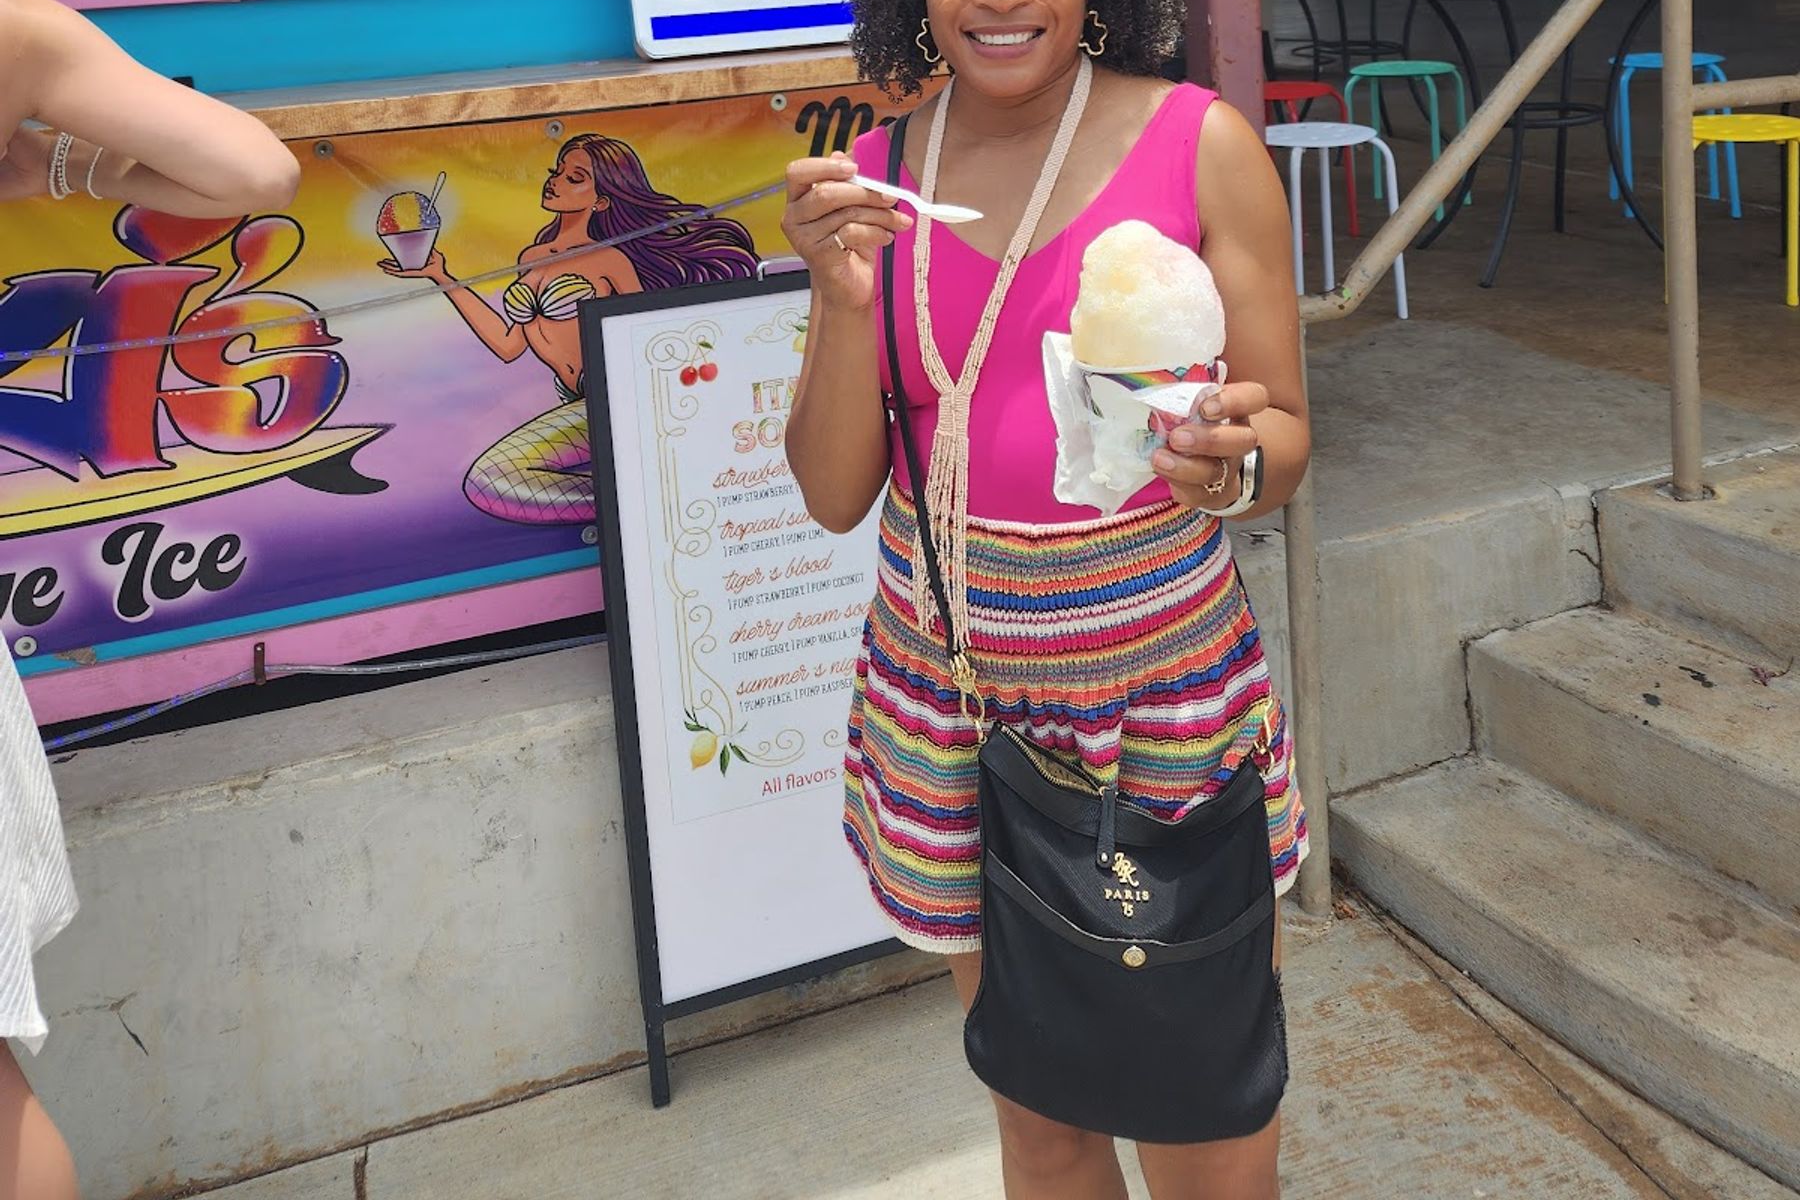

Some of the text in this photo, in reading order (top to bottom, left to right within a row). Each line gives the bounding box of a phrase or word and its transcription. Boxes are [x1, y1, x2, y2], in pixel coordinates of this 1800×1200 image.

[732, 414, 787, 454] SO
[713, 458, 797, 489] strawber
[721, 493, 744, 507] PUMP
[718, 508, 810, 541] tropical su
[729, 542, 750, 556] PUMP
[786, 531, 807, 545] PUMP
[101, 522, 247, 618] Ice
[785, 549, 834, 579] blood
[733, 596, 754, 610] PUMP
[811, 580, 833, 593] PUMP
[833, 573, 864, 588] COCONUT
[729, 621, 784, 644] cherry
[787, 608, 841, 632] cream
[737, 649, 759, 663] PUMP
[795, 636, 817, 650] PUMP
[830, 657, 856, 677] nig
[744, 697, 767, 713] PUMP
[799, 685, 820, 699] PUMP
[821, 678, 853, 695] RASPBER
[761, 767, 837, 797] All flavors
[1104, 888, 1150, 901] PARIS
